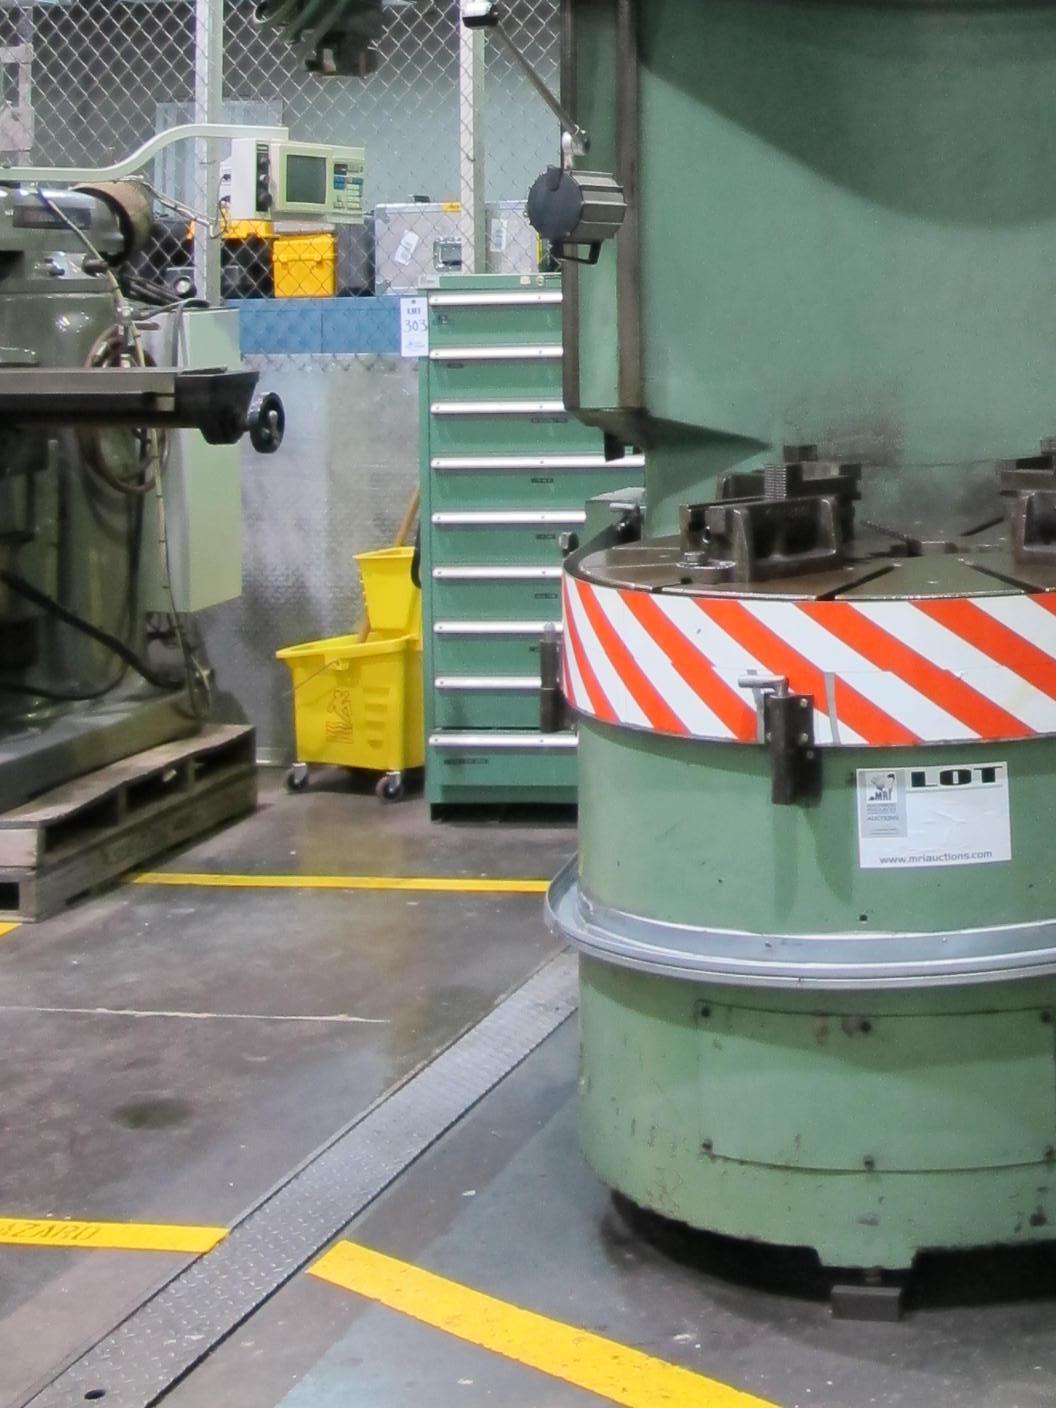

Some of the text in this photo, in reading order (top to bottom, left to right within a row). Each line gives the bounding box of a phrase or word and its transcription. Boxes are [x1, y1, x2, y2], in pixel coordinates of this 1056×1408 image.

[404, 319, 428, 332] 303
[910, 765, 1003, 788] LOT
[879, 850, 993, 865] www.mriauctions.com
